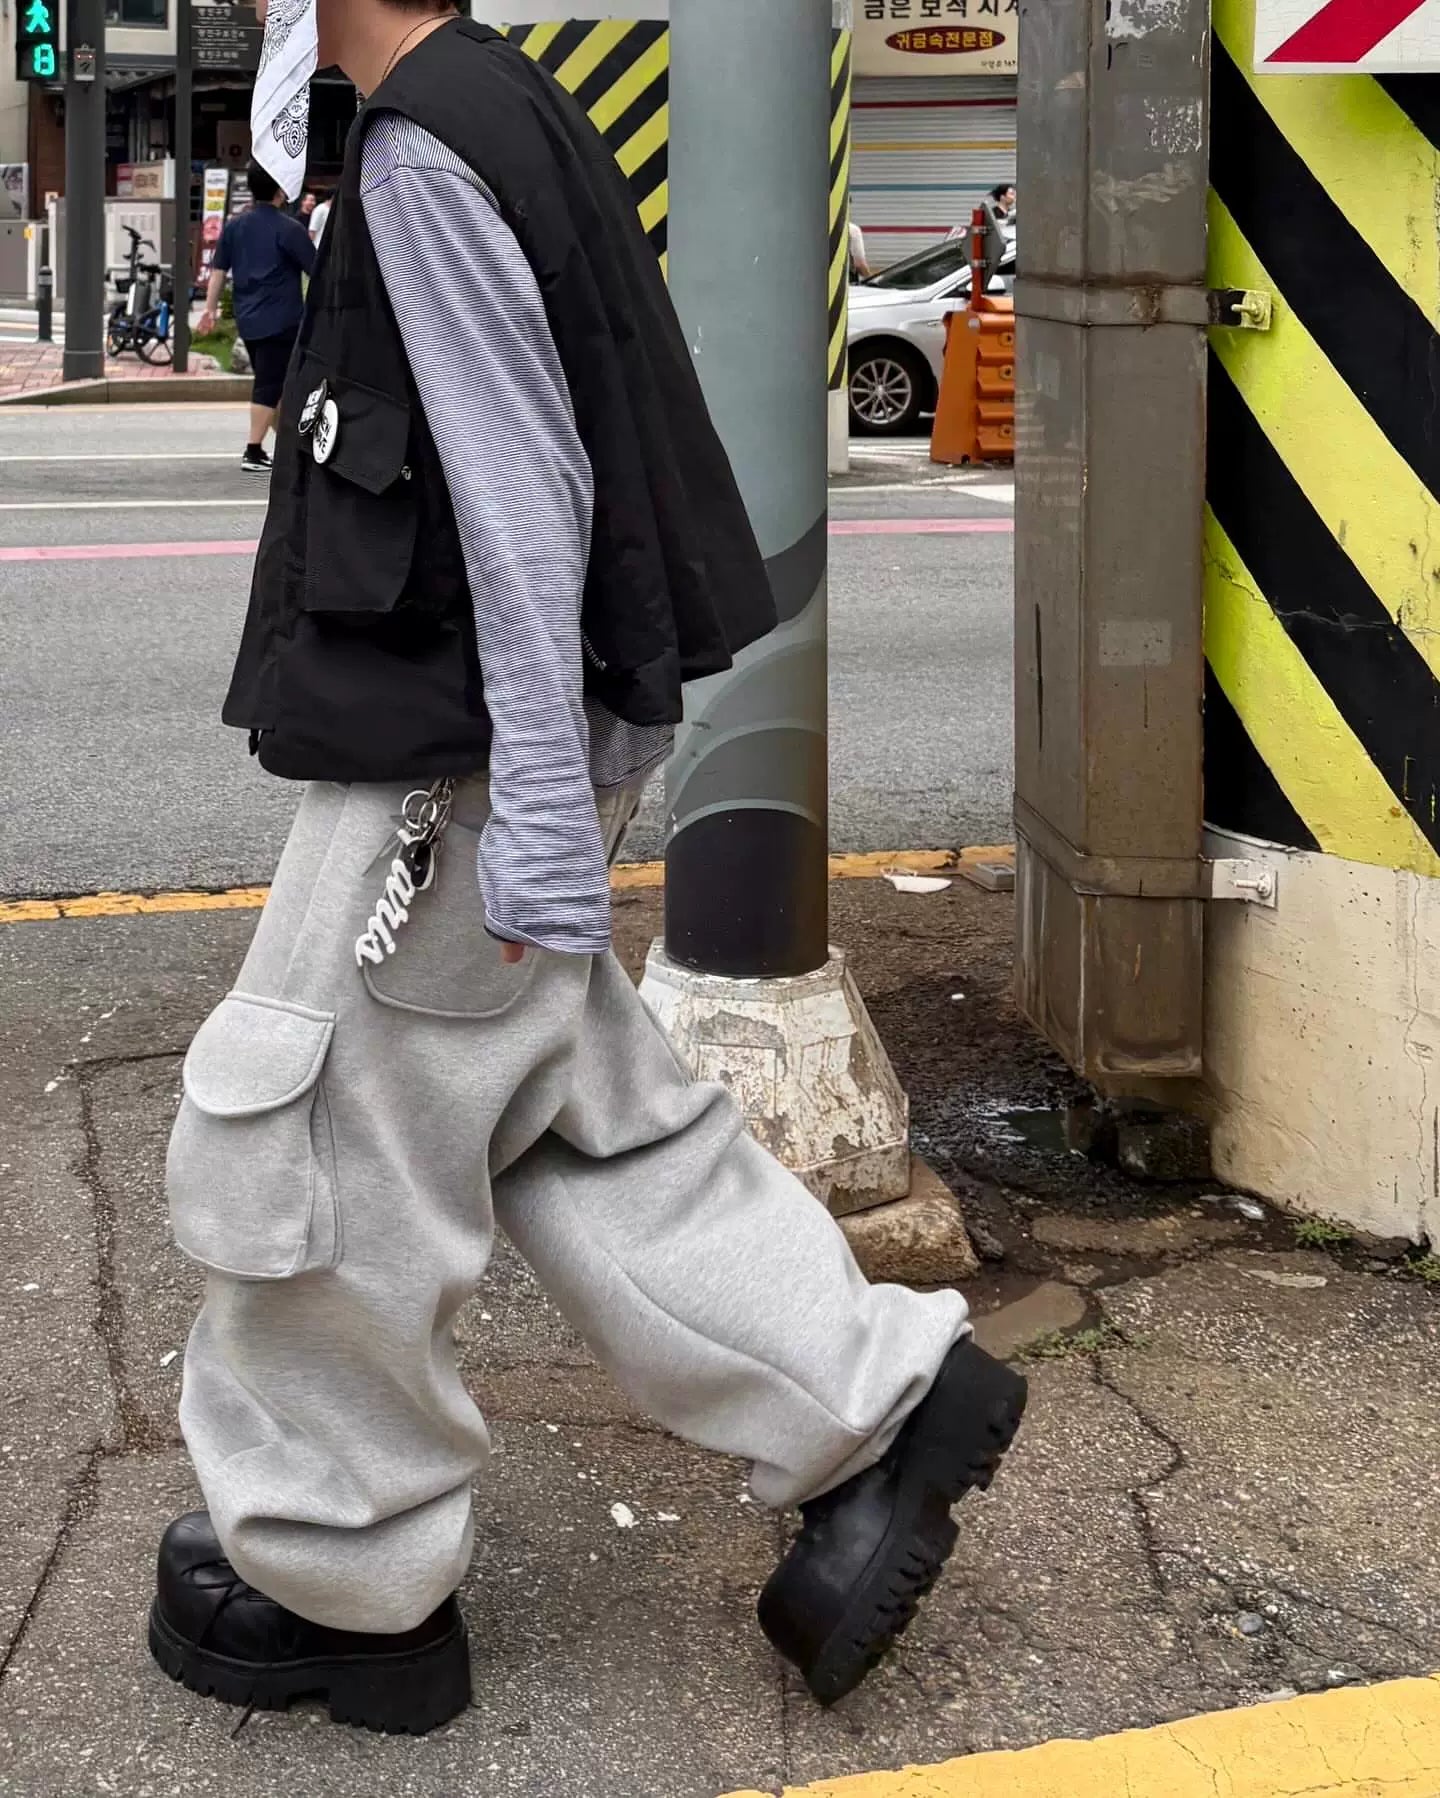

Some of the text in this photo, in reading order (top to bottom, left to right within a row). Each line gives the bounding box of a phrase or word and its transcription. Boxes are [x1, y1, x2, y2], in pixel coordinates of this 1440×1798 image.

[978, 0, 1019, 17] 시
[896, 31, 993, 49] 귀금속전문점
[34, 44, 55, 75] 8
